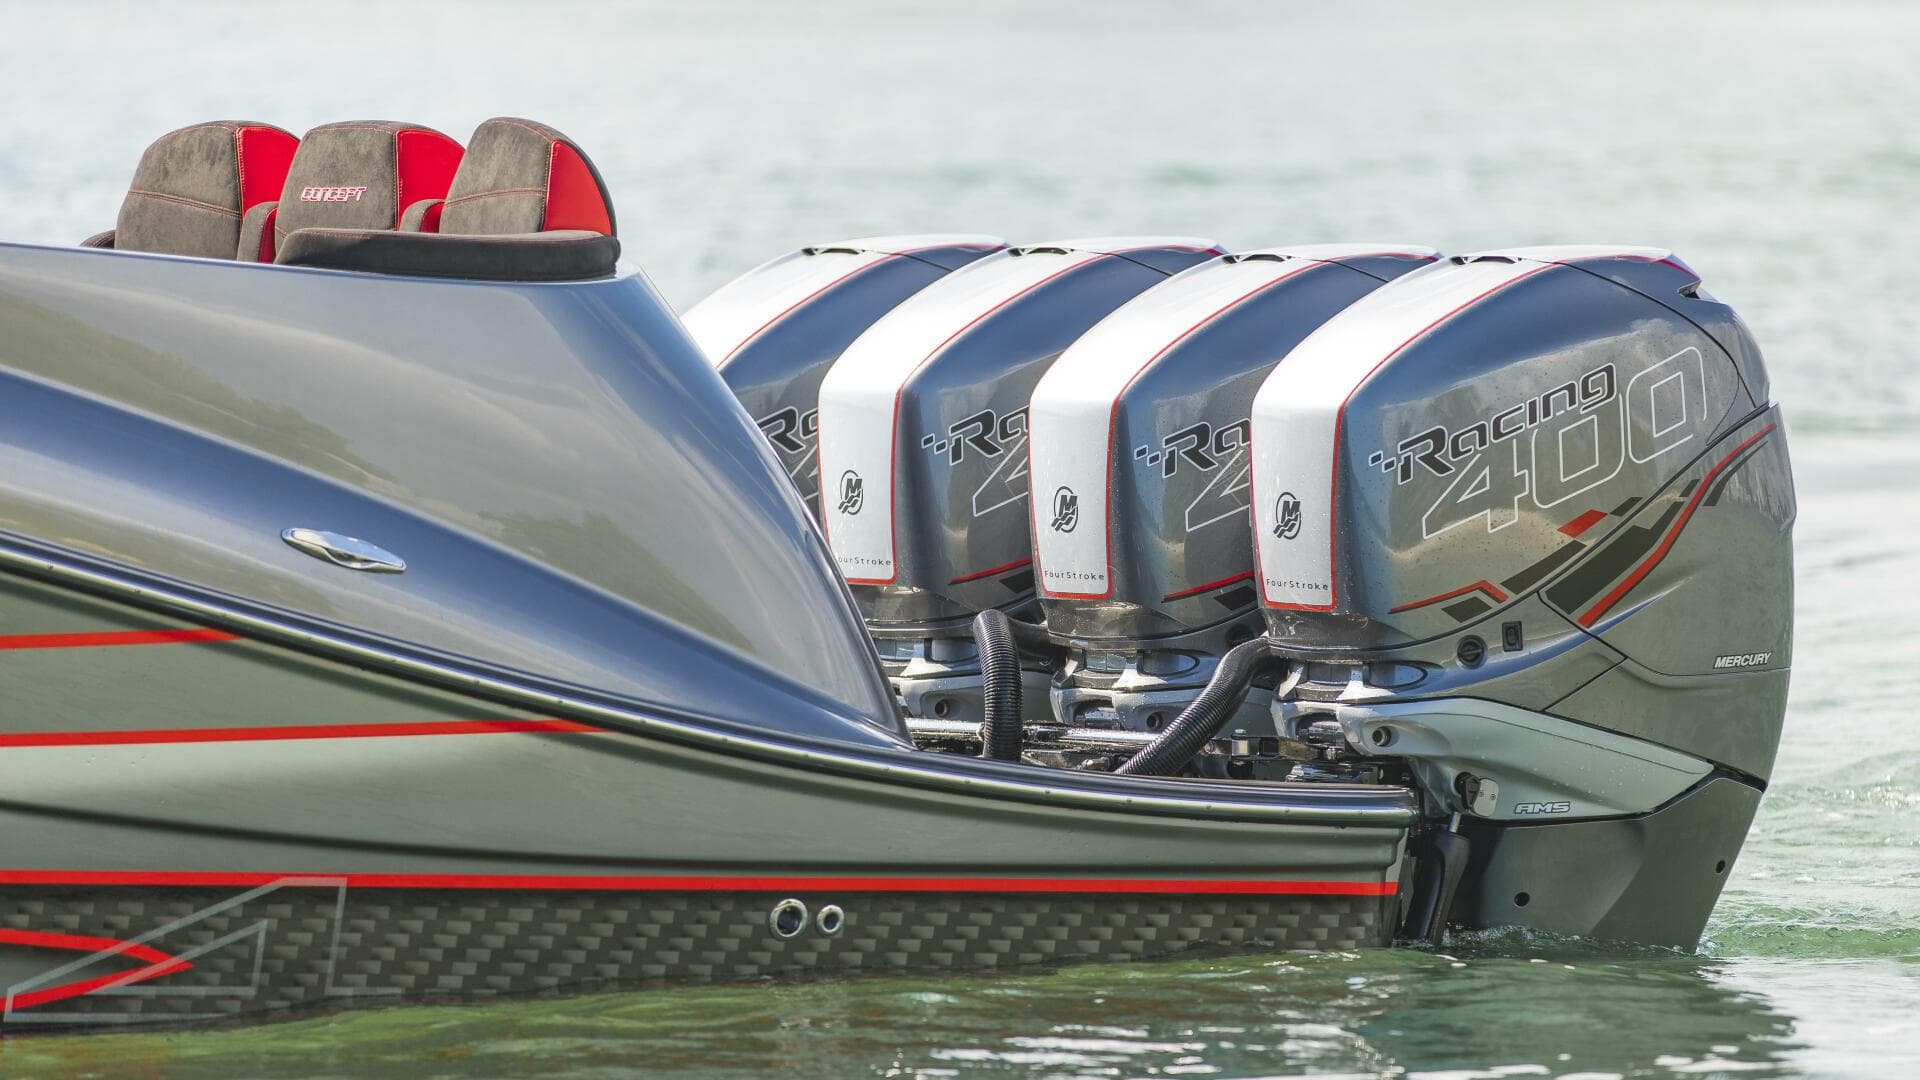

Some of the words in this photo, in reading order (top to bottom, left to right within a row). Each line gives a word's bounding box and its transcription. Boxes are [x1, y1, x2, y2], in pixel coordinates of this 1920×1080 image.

[1398, 362, 1617, 486] Racing
[1422, 346, 1706, 539] 400
[837, 556, 892, 566] ourStroke
[1044, 570, 1105, 581] FourStroke
[1266, 578, 1329, 591] FourStroke
[1713, 652, 1772, 669] MERCURY
[1515, 801, 1571, 814] AMS
